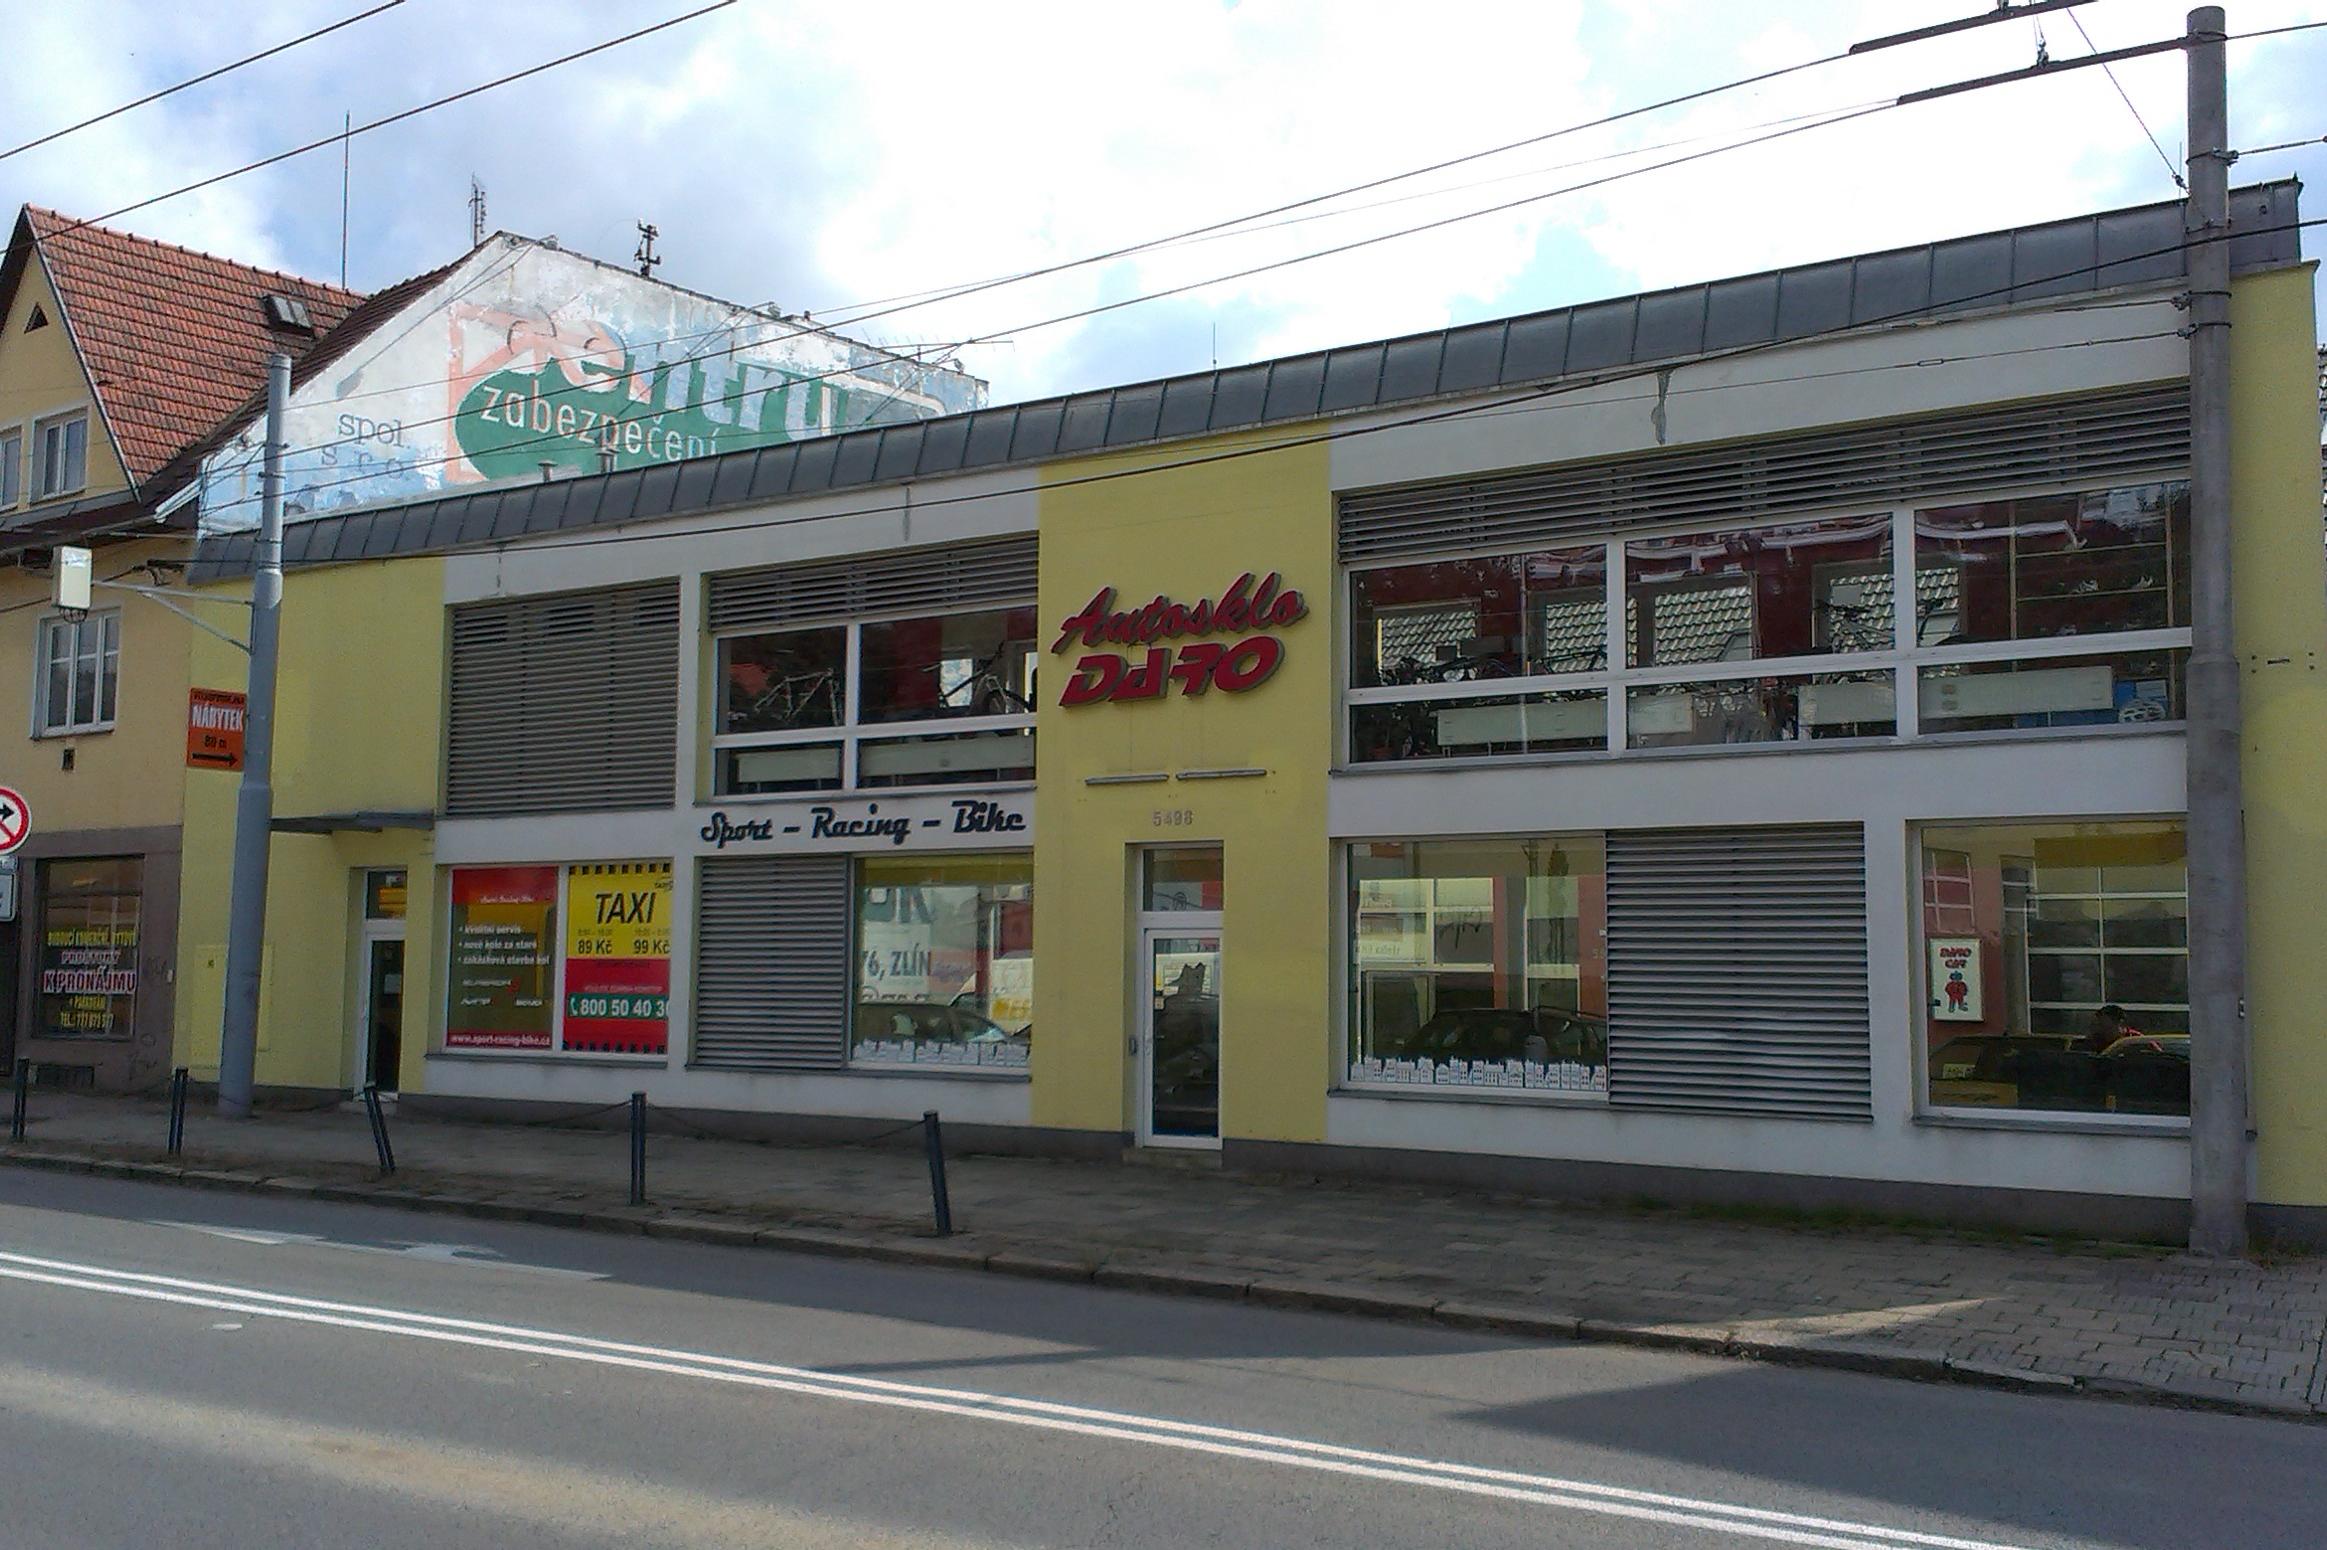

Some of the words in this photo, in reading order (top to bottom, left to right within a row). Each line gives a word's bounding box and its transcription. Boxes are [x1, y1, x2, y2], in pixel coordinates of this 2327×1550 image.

[480, 378, 719, 463] zabezpečení
[1051, 571, 1309, 655] Autosklo
[701, 811, 773, 849] Sport
[811, 803, 911, 845] Racing
[951, 800, 1026, 834] Bike
[595, 892, 656, 924] TAXI
[578, 939, 593, 954] 89
[596, 938, 612, 954] Kč
[634, 939, 649, 954] 99
[653, 938, 670, 954] Kč
[56, 965, 137, 995] PRONÁJMU
[580, 998, 607, 1016] 800
[611, 998, 629, 1016] 50
[633, 998, 652, 1017] 40
